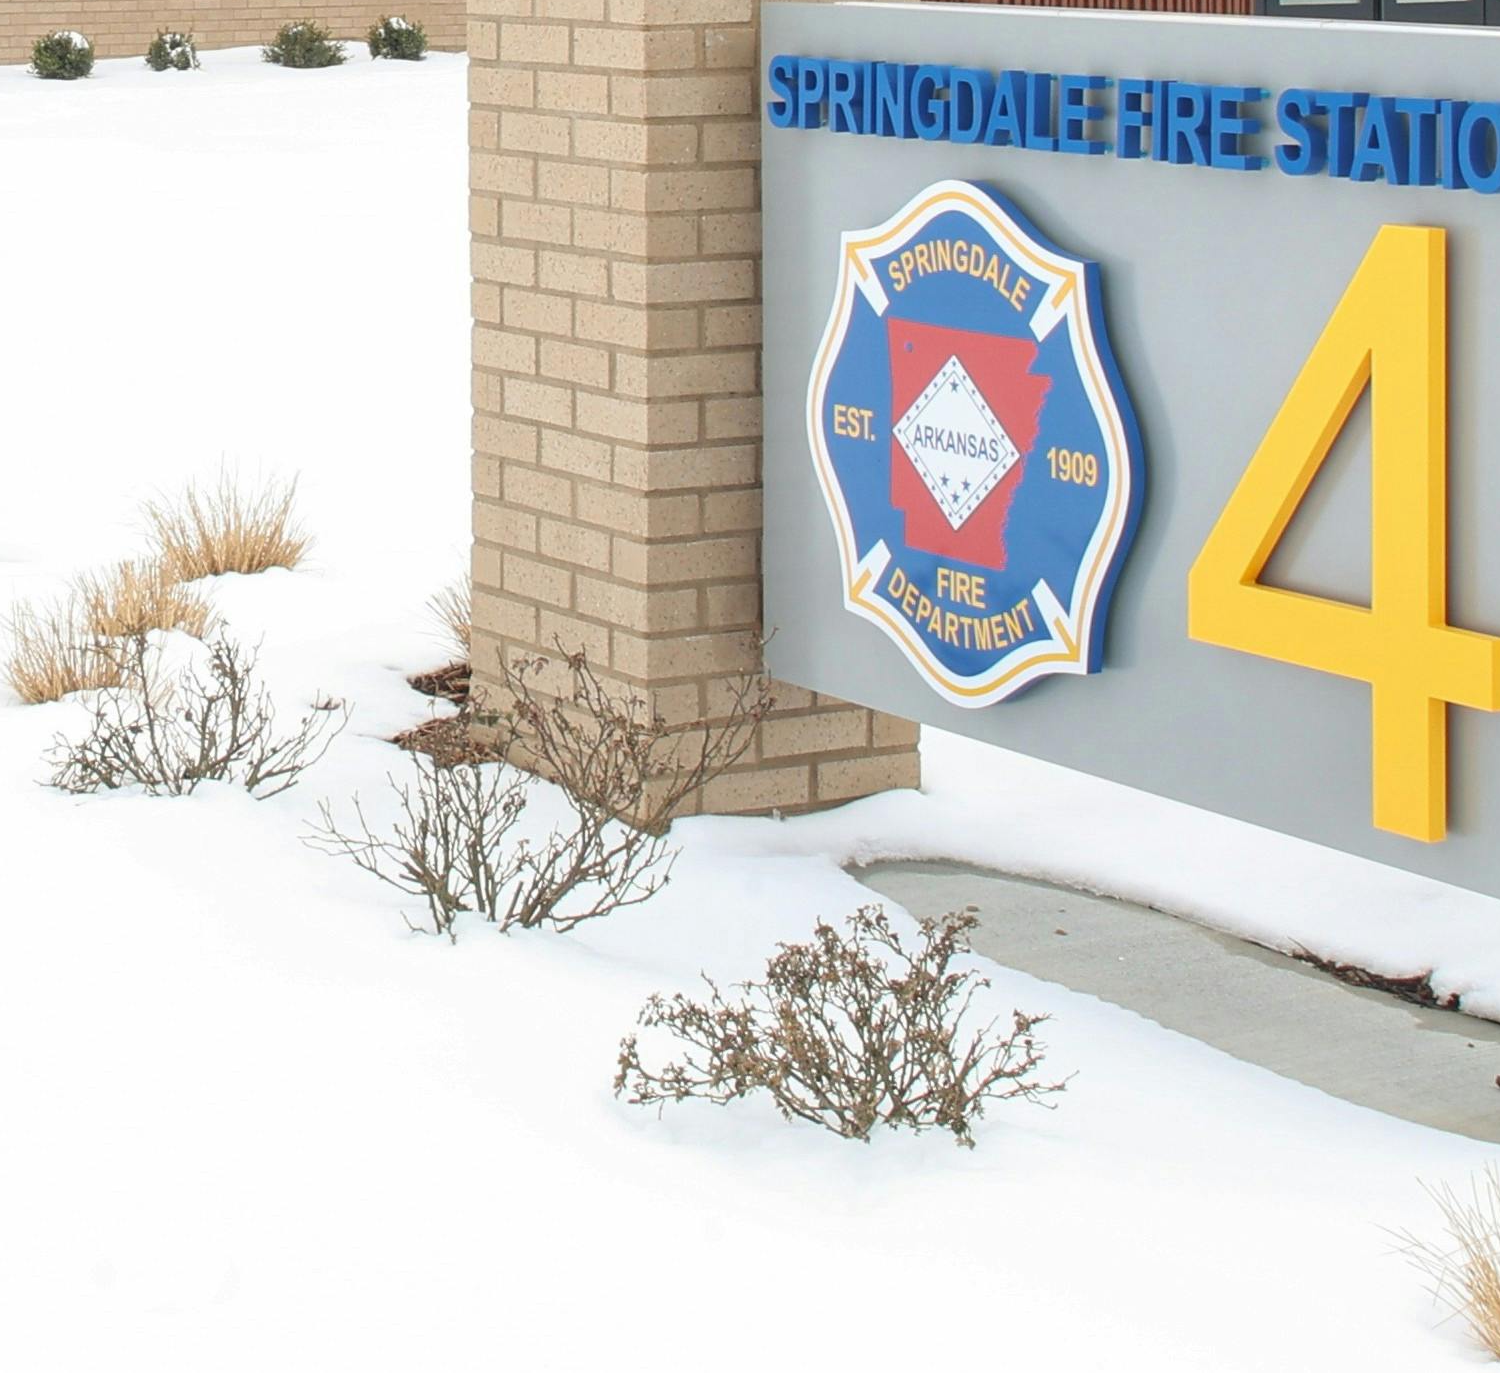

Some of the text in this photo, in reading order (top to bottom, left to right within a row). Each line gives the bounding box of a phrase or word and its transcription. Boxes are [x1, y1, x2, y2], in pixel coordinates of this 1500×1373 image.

[766, 54, 1105, 156] SPRINGDALE
[1116, 78, 1262, 171] FIRE
[888, 239, 1031, 312] SPRINGDALE
[833, 404, 876, 441] EST.
[912, 424, 999, 463] ARKANSAS
[1047, 446, 1098, 487] 1909
[888, 567, 1034, 651] DEPARTMENT
[937, 567, 986, 609] FIRE
